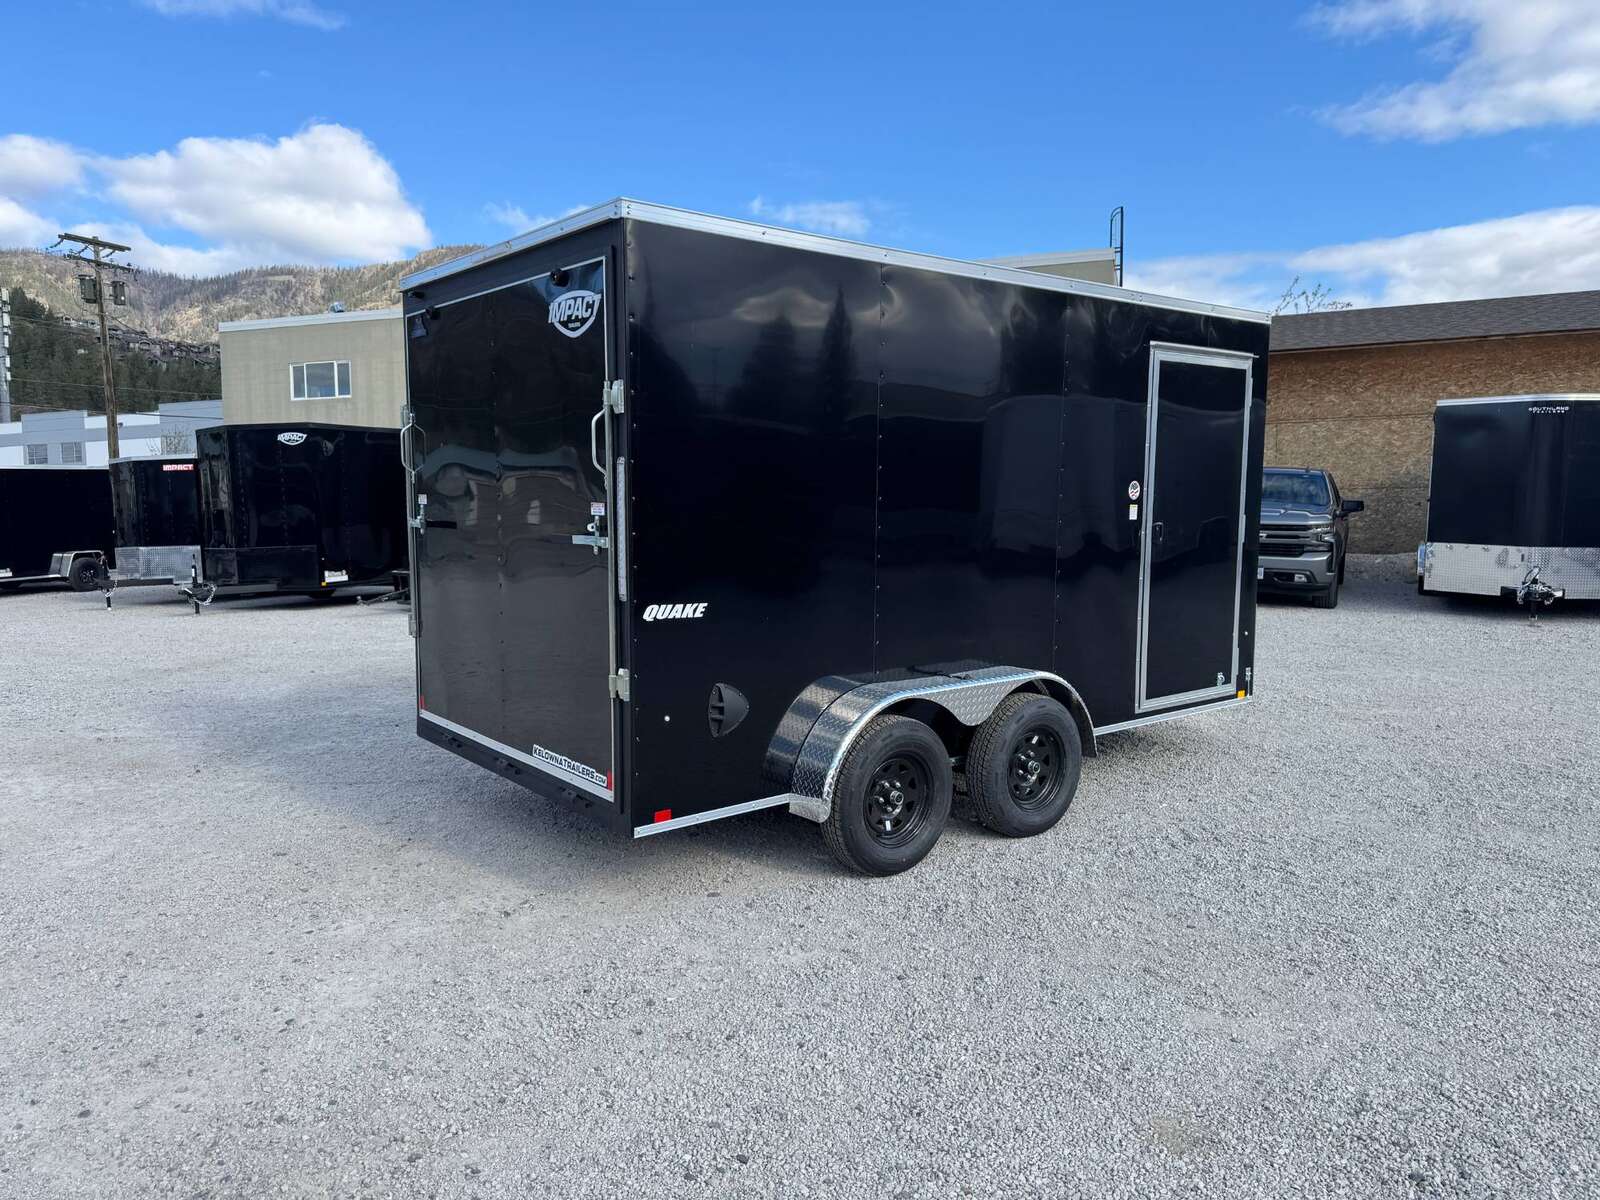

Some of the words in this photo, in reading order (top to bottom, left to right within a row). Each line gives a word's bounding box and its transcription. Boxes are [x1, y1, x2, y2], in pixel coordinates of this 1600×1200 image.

[548, 293, 602, 323] IMPACT
[277, 433, 308, 442] IMPACT
[642, 602, 708, 621] QUAKE
